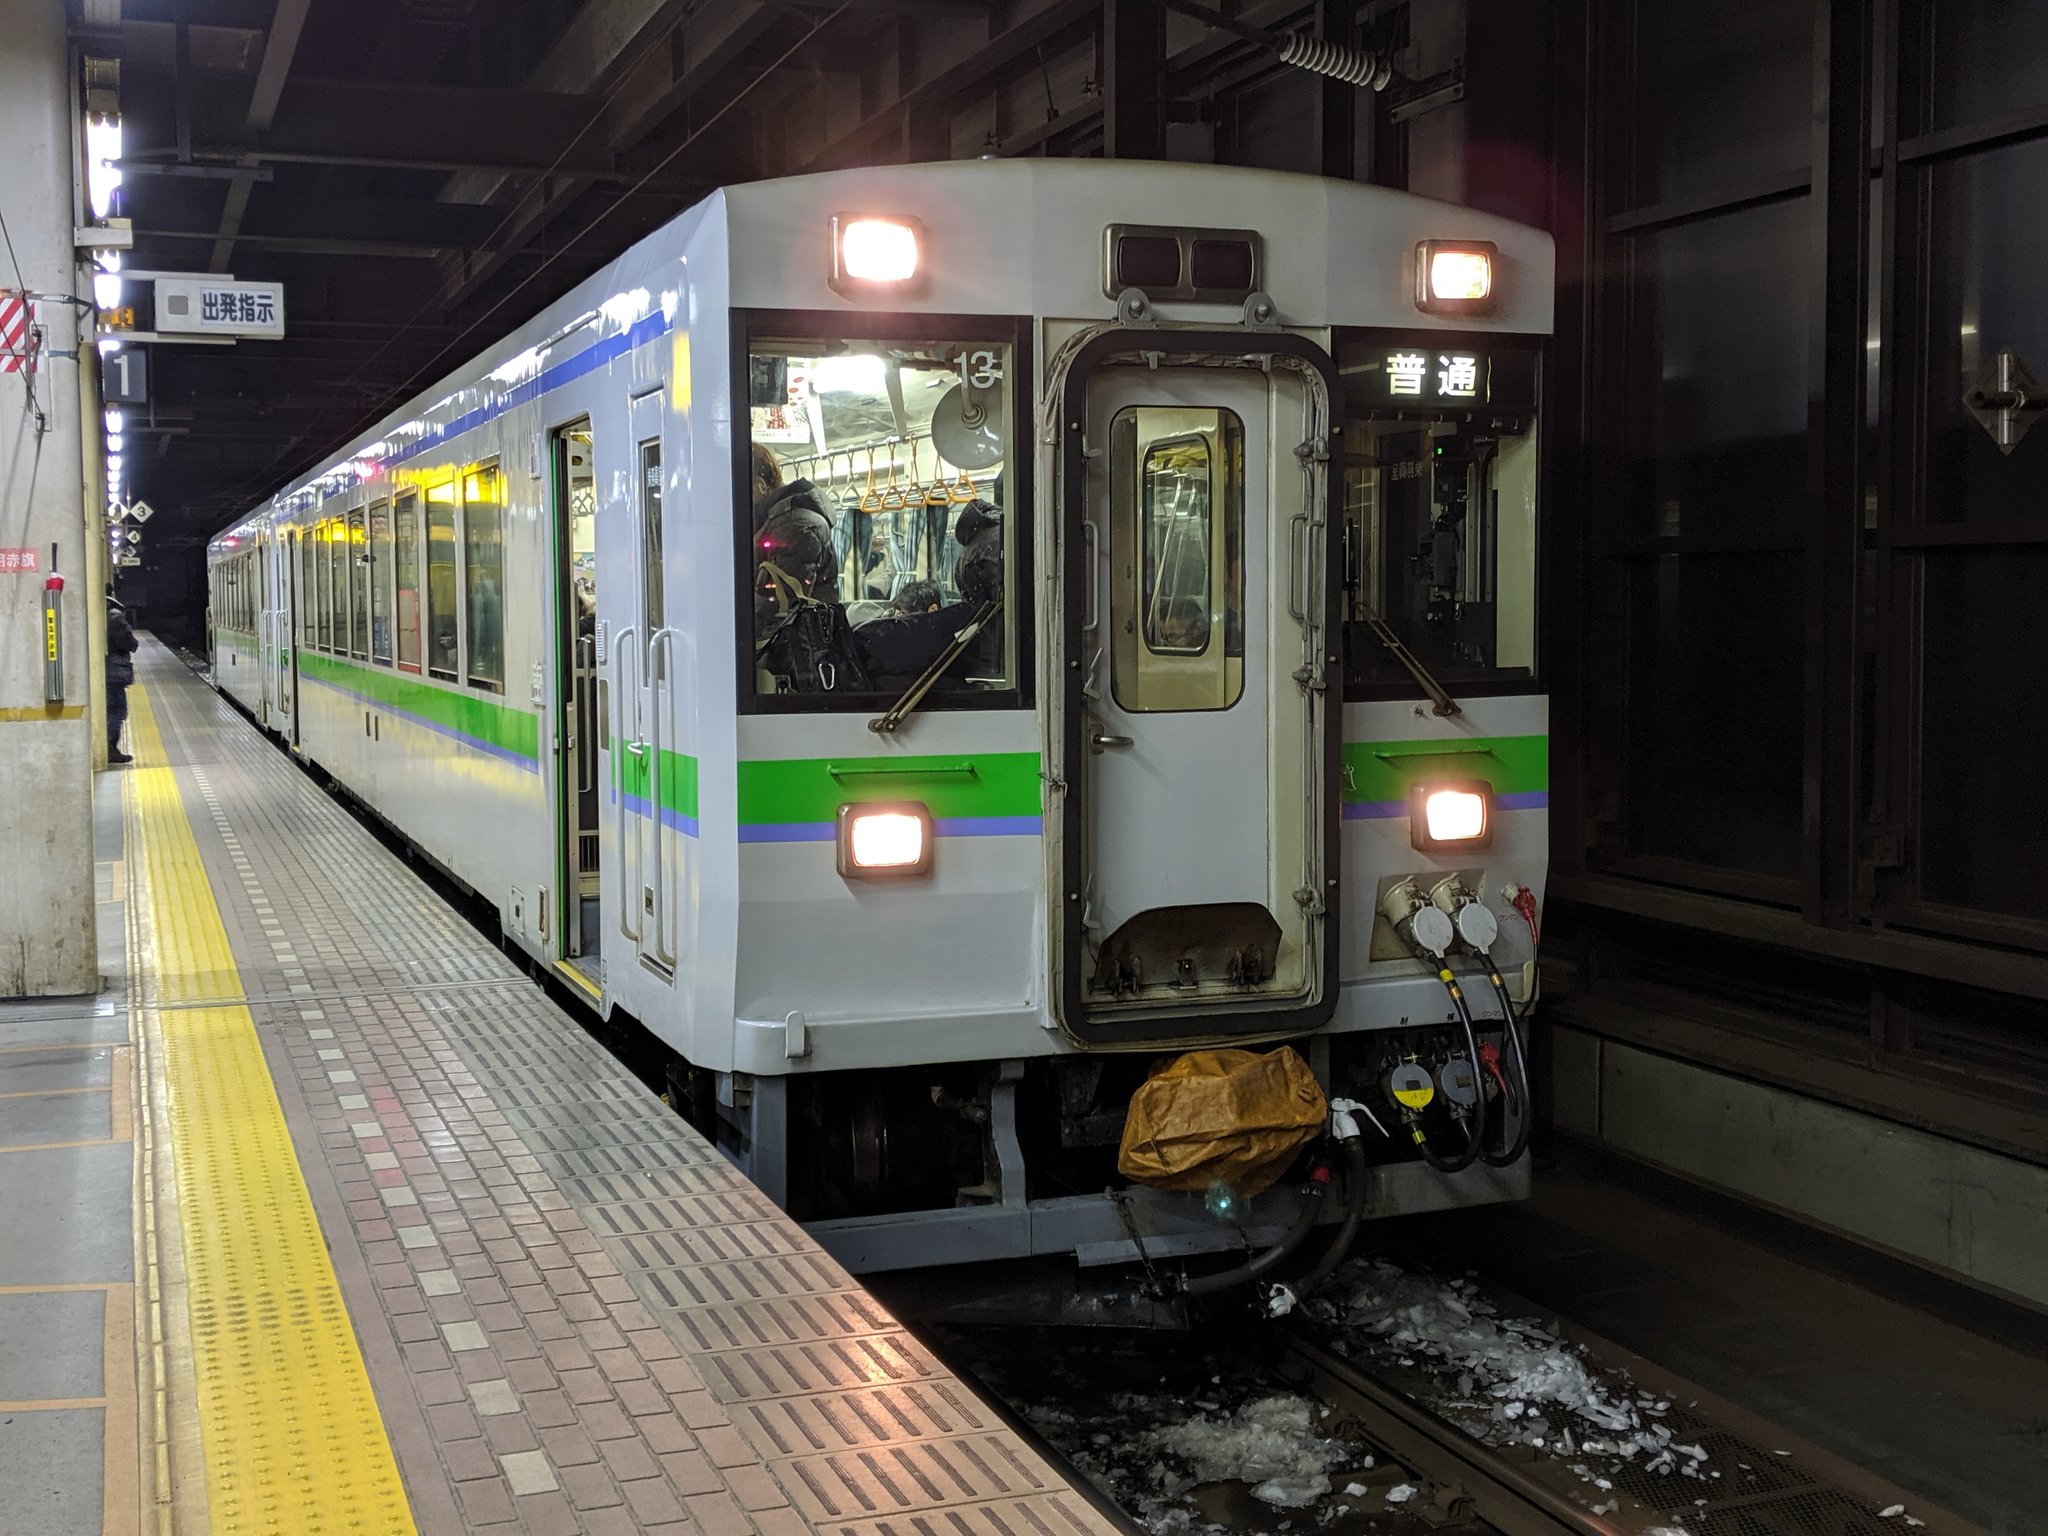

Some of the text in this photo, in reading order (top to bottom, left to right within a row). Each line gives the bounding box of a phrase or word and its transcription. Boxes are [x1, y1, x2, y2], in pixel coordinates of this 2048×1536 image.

[203, 293, 274, 322] 出発指示
[113, 354, 129, 396] 1
[953, 351, 995, 389] 13
[1386, 353, 1477, 397] 普通
[137, 506, 146, 517] 3
